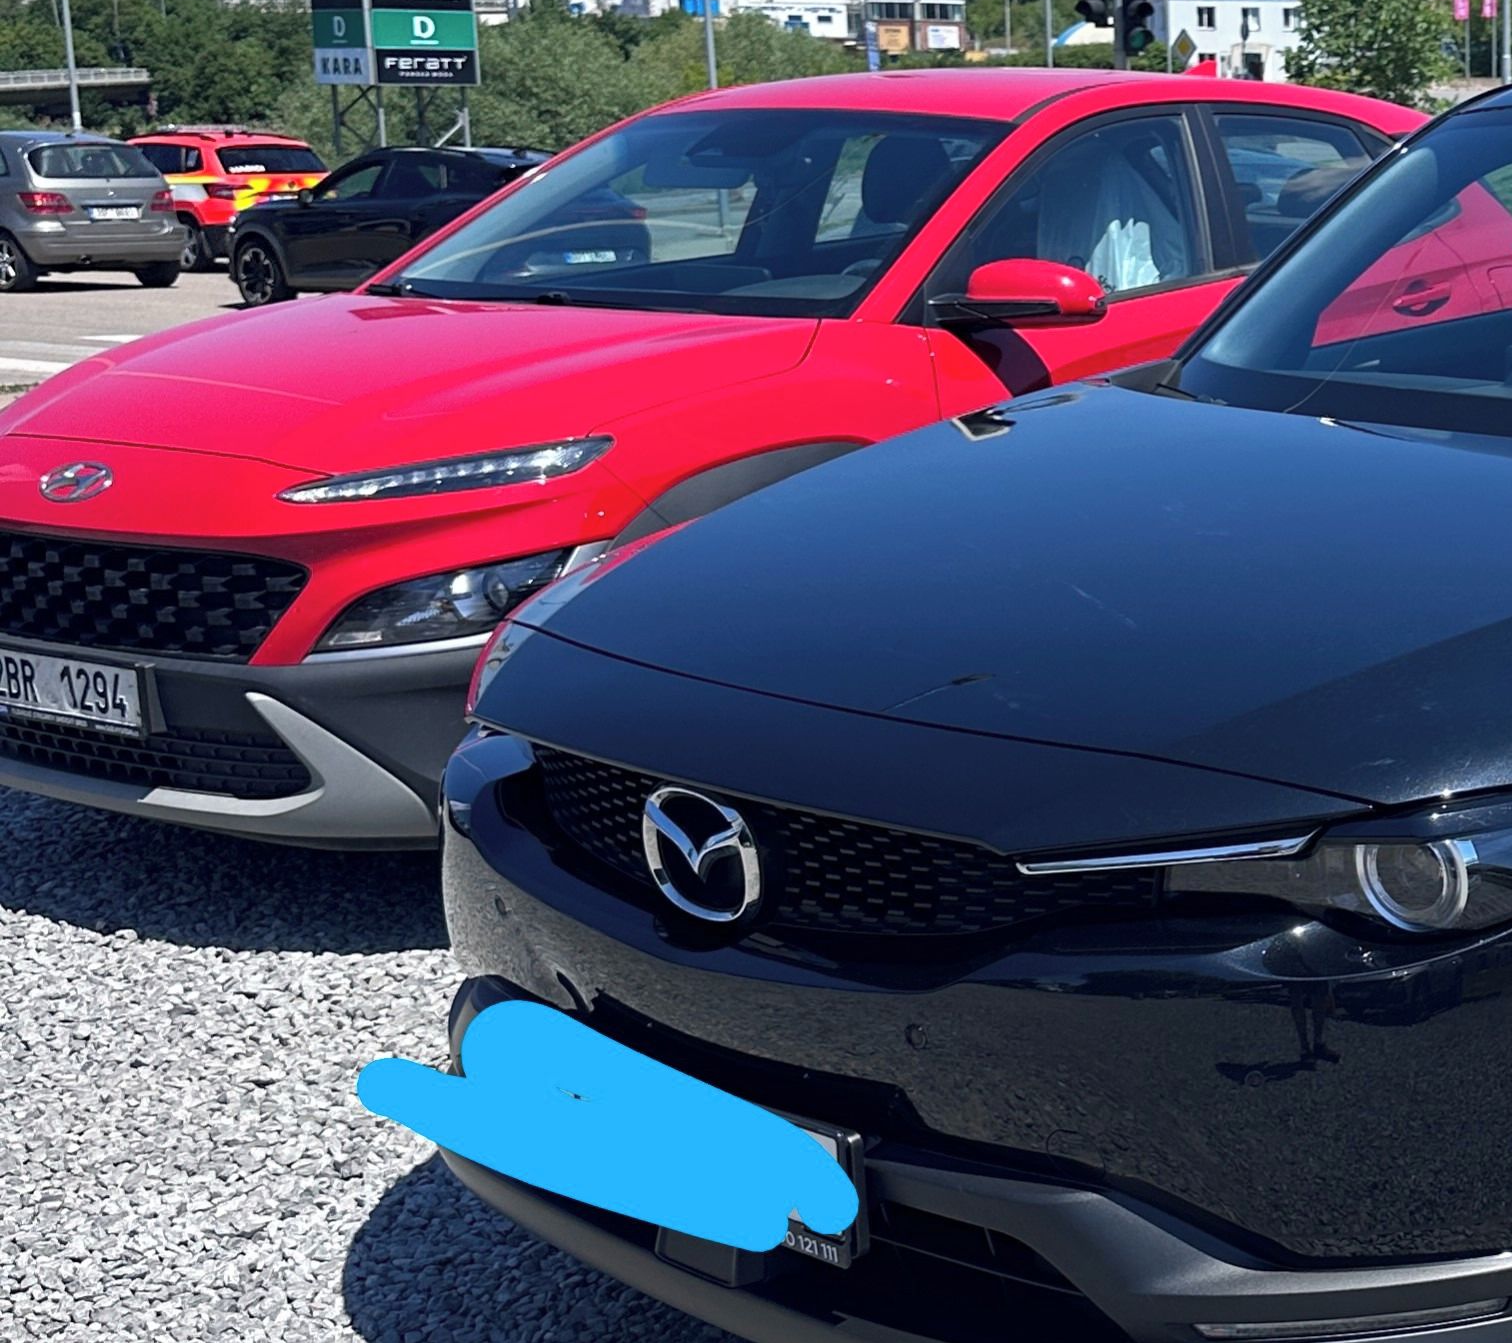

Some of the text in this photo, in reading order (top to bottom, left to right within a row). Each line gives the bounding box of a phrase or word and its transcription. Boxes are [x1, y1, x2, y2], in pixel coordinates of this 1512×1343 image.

[333, 16, 346, 38] D
[413, 16, 436, 39] D
[321, 57, 362, 76] KARA
[0, 655, 127, 718] BR 1294
[798, 1235, 818, 1256] 121
[820, 1242, 839, 1263] 111
